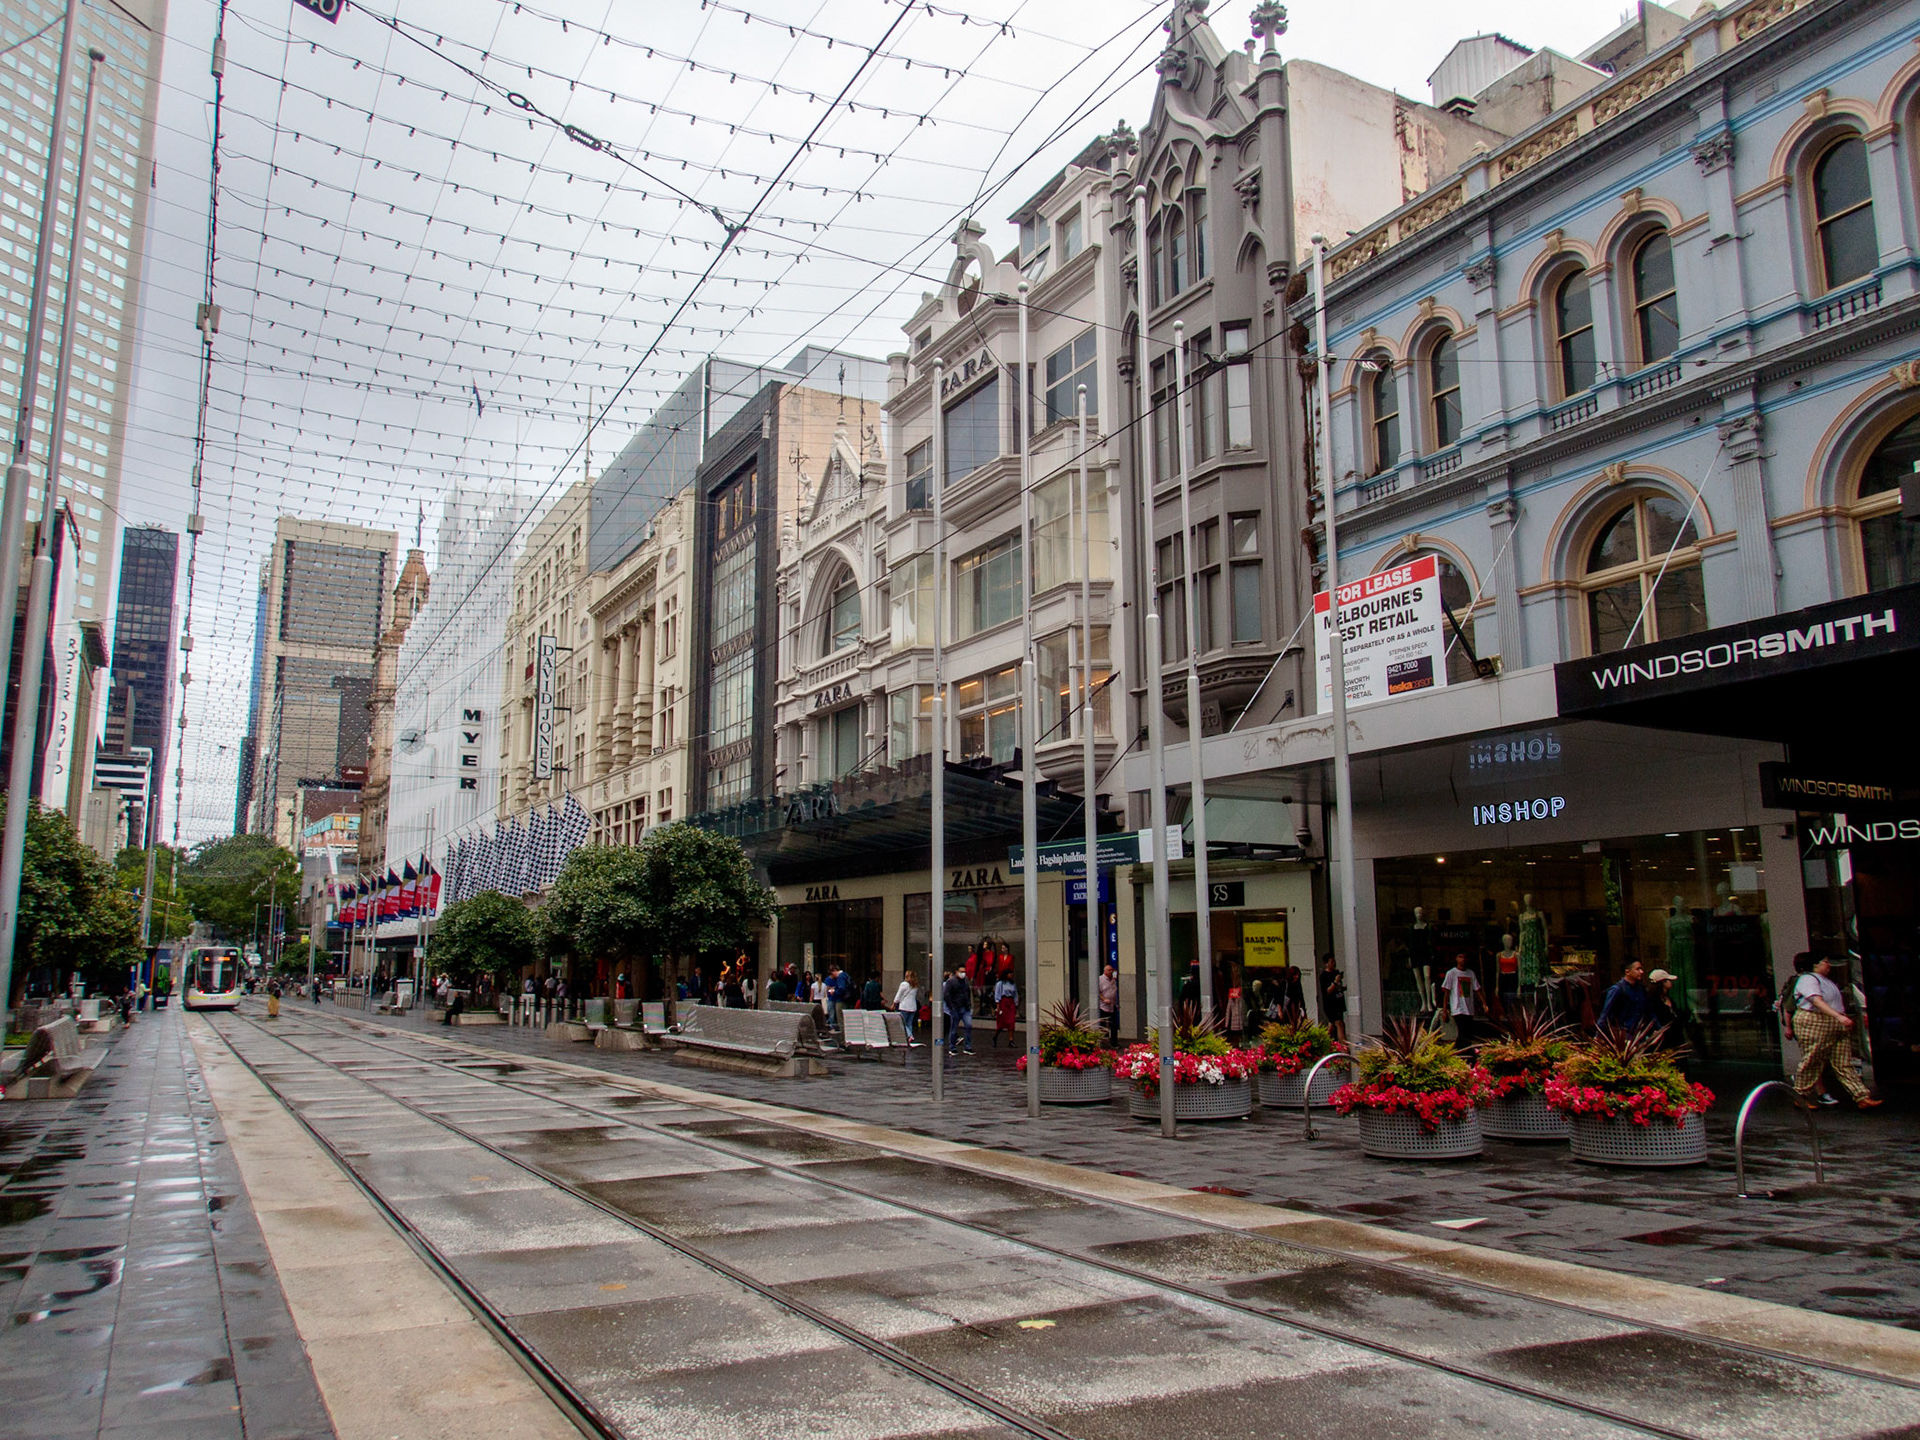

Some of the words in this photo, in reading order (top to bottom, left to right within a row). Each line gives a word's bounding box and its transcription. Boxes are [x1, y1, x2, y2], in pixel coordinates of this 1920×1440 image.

[941, 349, 992, 397] ZARA
[1366, 567, 1412, 595] LEASE
[1369, 608, 1419, 635] RETAIL
[1349, 638, 1385, 654] SEPARATELY
[1386, 636, 1396, 644] OR
[1397, 633, 1405, 641] AS
[1413, 624, 1436, 636] WHOLE
[1592, 608, 1897, 690] WINDSORSMITH
[541, 644, 554, 705] DAVID
[1387, 663, 1402, 675] 9421
[1403, 660, 1419, 670] 7000
[814, 682, 853, 709] ZARA
[1352, 689, 1373, 700] RETAIL
[460, 708, 482, 790] MYER
[539, 709, 552, 773] JONES
[1778, 777, 1893, 800] WINDSORSMITH
[785, 793, 839, 825] ZARA
[1473, 796, 1566, 826] INSHOP
[1808, 819, 1920, 846] WINDS
[951, 867, 1004, 888] ZARA
[806, 885, 840, 901] ZARA
